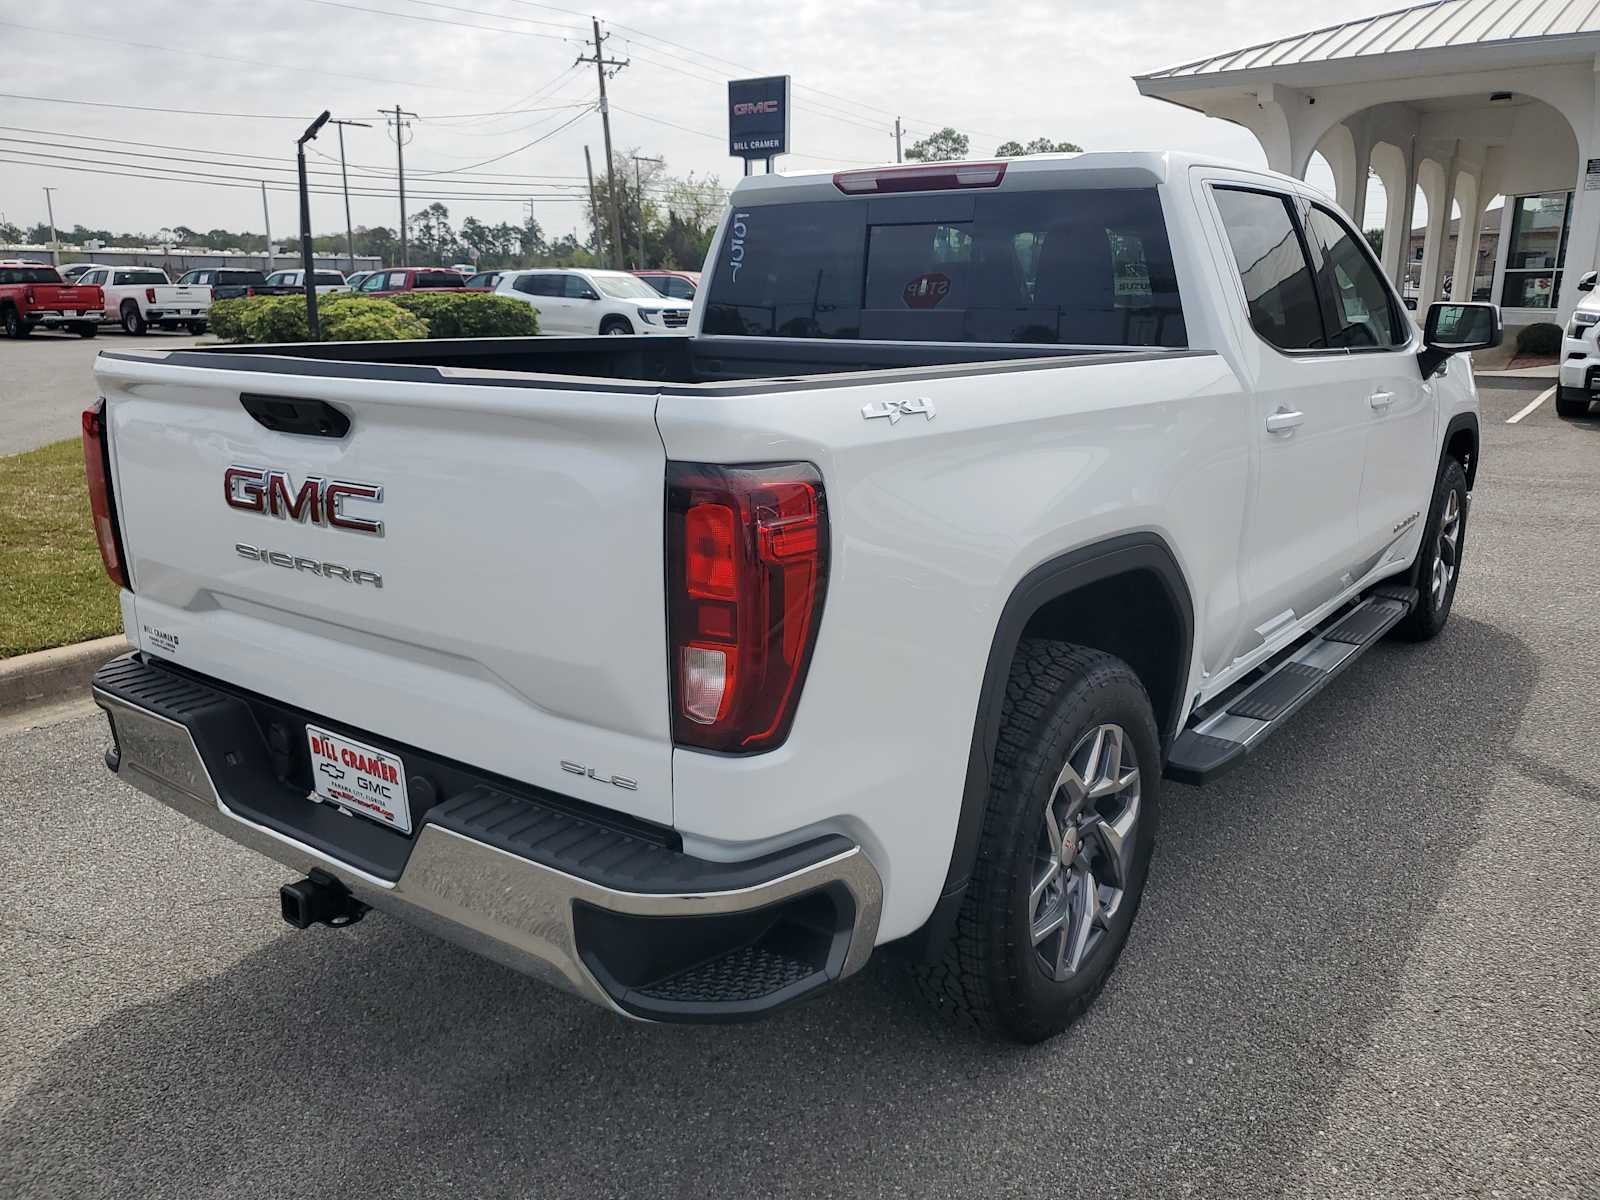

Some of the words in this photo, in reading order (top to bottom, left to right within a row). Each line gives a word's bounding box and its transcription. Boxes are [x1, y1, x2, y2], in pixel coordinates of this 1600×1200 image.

[734, 100, 778, 115] GMC
[733, 142, 749, 150] BILL
[750, 140, 779, 149] CRAMER
[224, 465, 385, 538] GMC
[235, 542, 383, 588] SIERRA
[311, 736, 338, 762] BILL
[341, 748, 399, 785] CRAMER
[331, 781, 352, 793] PANAMA
[357, 776, 393, 799] GMC
[560, 760, 638, 791] SLE
